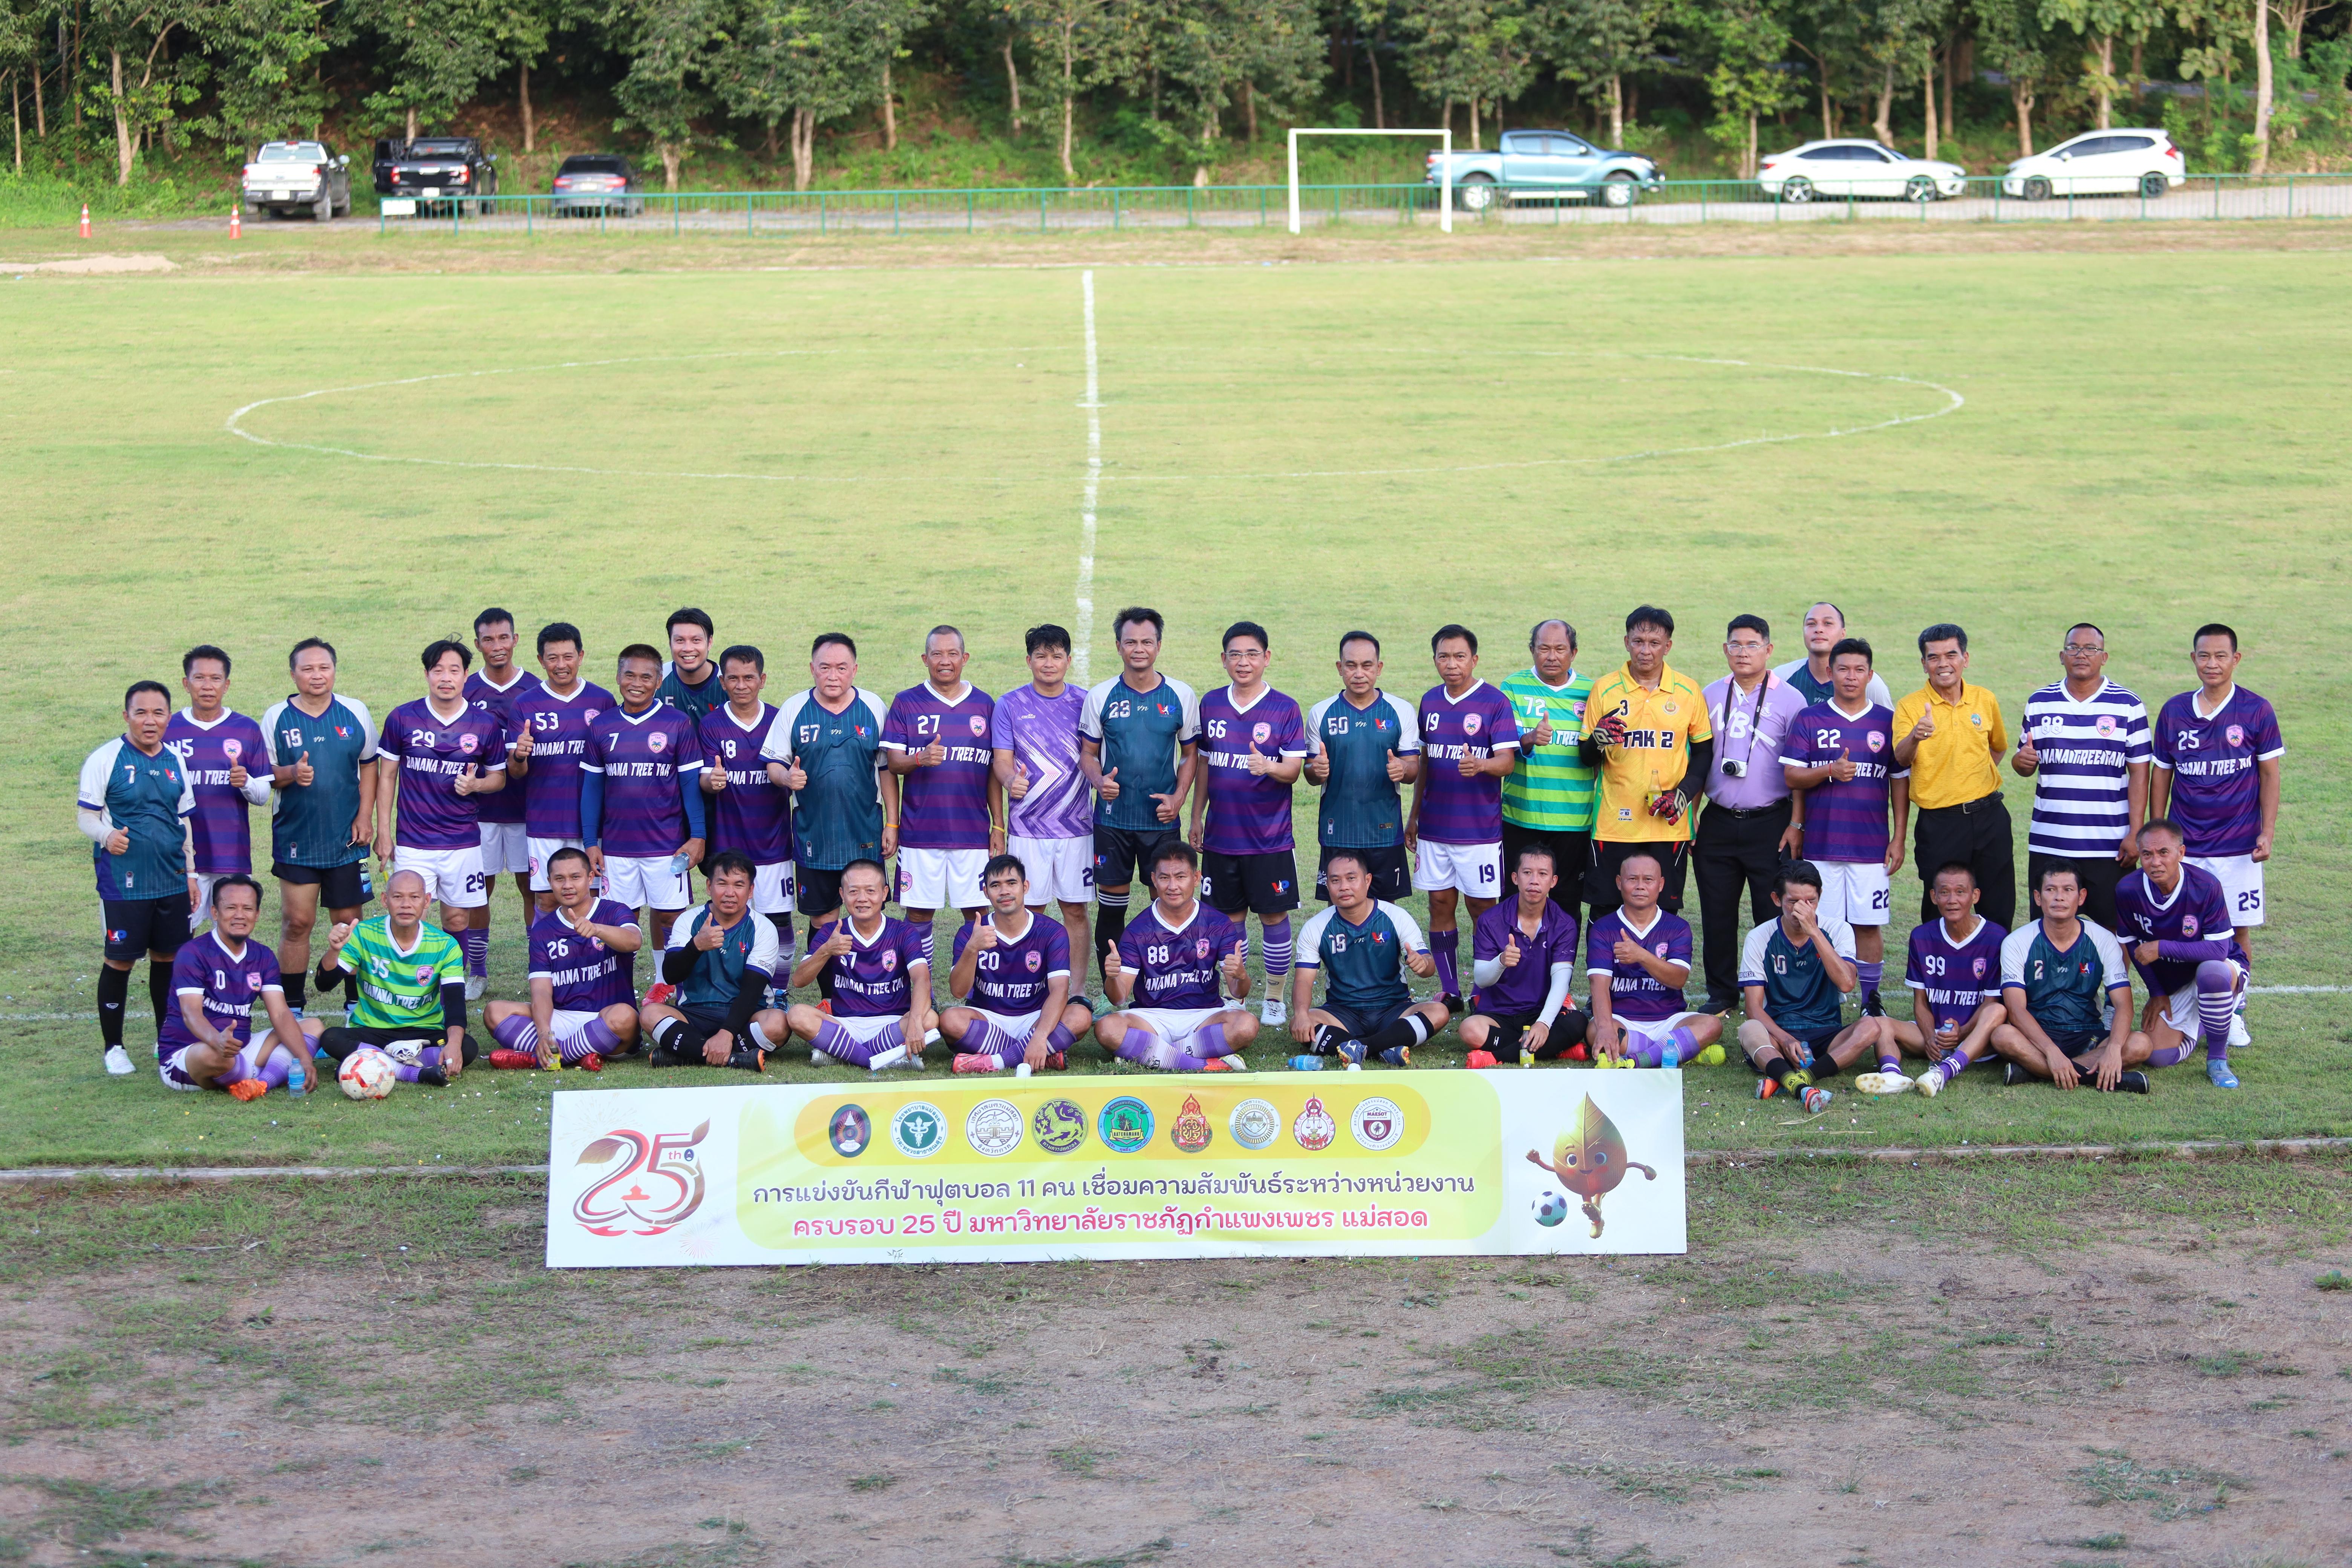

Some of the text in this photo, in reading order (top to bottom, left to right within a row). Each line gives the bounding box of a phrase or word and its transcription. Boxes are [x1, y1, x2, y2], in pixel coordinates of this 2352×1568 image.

[1109, 699, 1131, 719] 23
[1523, 695, 1546, 717] 72
[1620, 699, 1629, 716] 3
[535, 712, 559, 731] 53
[917, 714, 941, 735] 27
[1208, 719, 1228, 739] 66
[1328, 716, 1349, 735] 50
[1426, 712, 1440, 732] 19
[2041, 715, 2064, 735] 88
[282, 728, 303, 749] 18
[411, 729, 435, 748] 29
[609, 732, 619, 752] 7
[799, 723, 821, 743] 57
[1556, 730, 1579, 747] TREE
[1622, 729, 1675, 749] TAK 2
[1817, 729, 1841, 749] 22
[2178, 730, 2200, 751] 25
[567, 740, 586, 755] TRE
[720, 739, 737, 759] 18
[951, 746, 976, 762] TREE
[975, 747, 992, 766] TAK
[1471, 746, 1489, 759] TAK
[406, 755, 439, 773] BANANA
[439, 760, 466, 775] TREE
[631, 762, 654, 777] TREE
[1231, 754, 1250, 770] TRE
[2210, 758, 2236, 776] TREE
[124, 765, 135, 784] 7
[204, 769, 231, 786] TREE
[466, 871, 485, 893] 29
[675, 872, 683, 893] 7
[1082, 867, 1094, 887] 2
[1479, 863, 1495, 884] 19
[780, 876, 795, 898] 18
[1872, 888, 1889, 910] 22
[2239, 889, 2260, 911] 25
[2133, 912, 2154, 935] 42
[547, 938, 569, 960] 26
[1329, 933, 1347, 954] 18
[978, 949, 1000, 971] 20
[1147, 944, 1170, 965] 88
[1771, 954, 1787, 975] 10
[370, 955, 392, 980] 35
[581, 962, 602, 982] TREE
[1925, 954, 1945, 977] 99
[2034, 960, 2044, 980] 2
[834, 974, 865, 994] BANANA
[867, 982, 890, 995] TREE
[1007, 983, 1032, 999] TREE
[1145, 973, 1178, 992] ANANA
[363, 980, 393, 1005] BANANA
[395, 994, 421, 1011] TREE
[1954, 990, 1975, 1006] TREE
[673, 1033, 683, 1051] EGO
[1319, 1034, 1332, 1052] EGO
[668, 1149, 683, 1161] th
[753, 1167, 1475, 1207] การแข่งขันกีฬาฟุตบอล 11 คน เชื่อมความสัมพันธ์ระหว่างหน่วยงาน
[793, 1204, 1428, 1236] ครบรอบ 25 ปี มหาวิทยาลัยราชภัฏกำแพงเพชร แม่สอด
